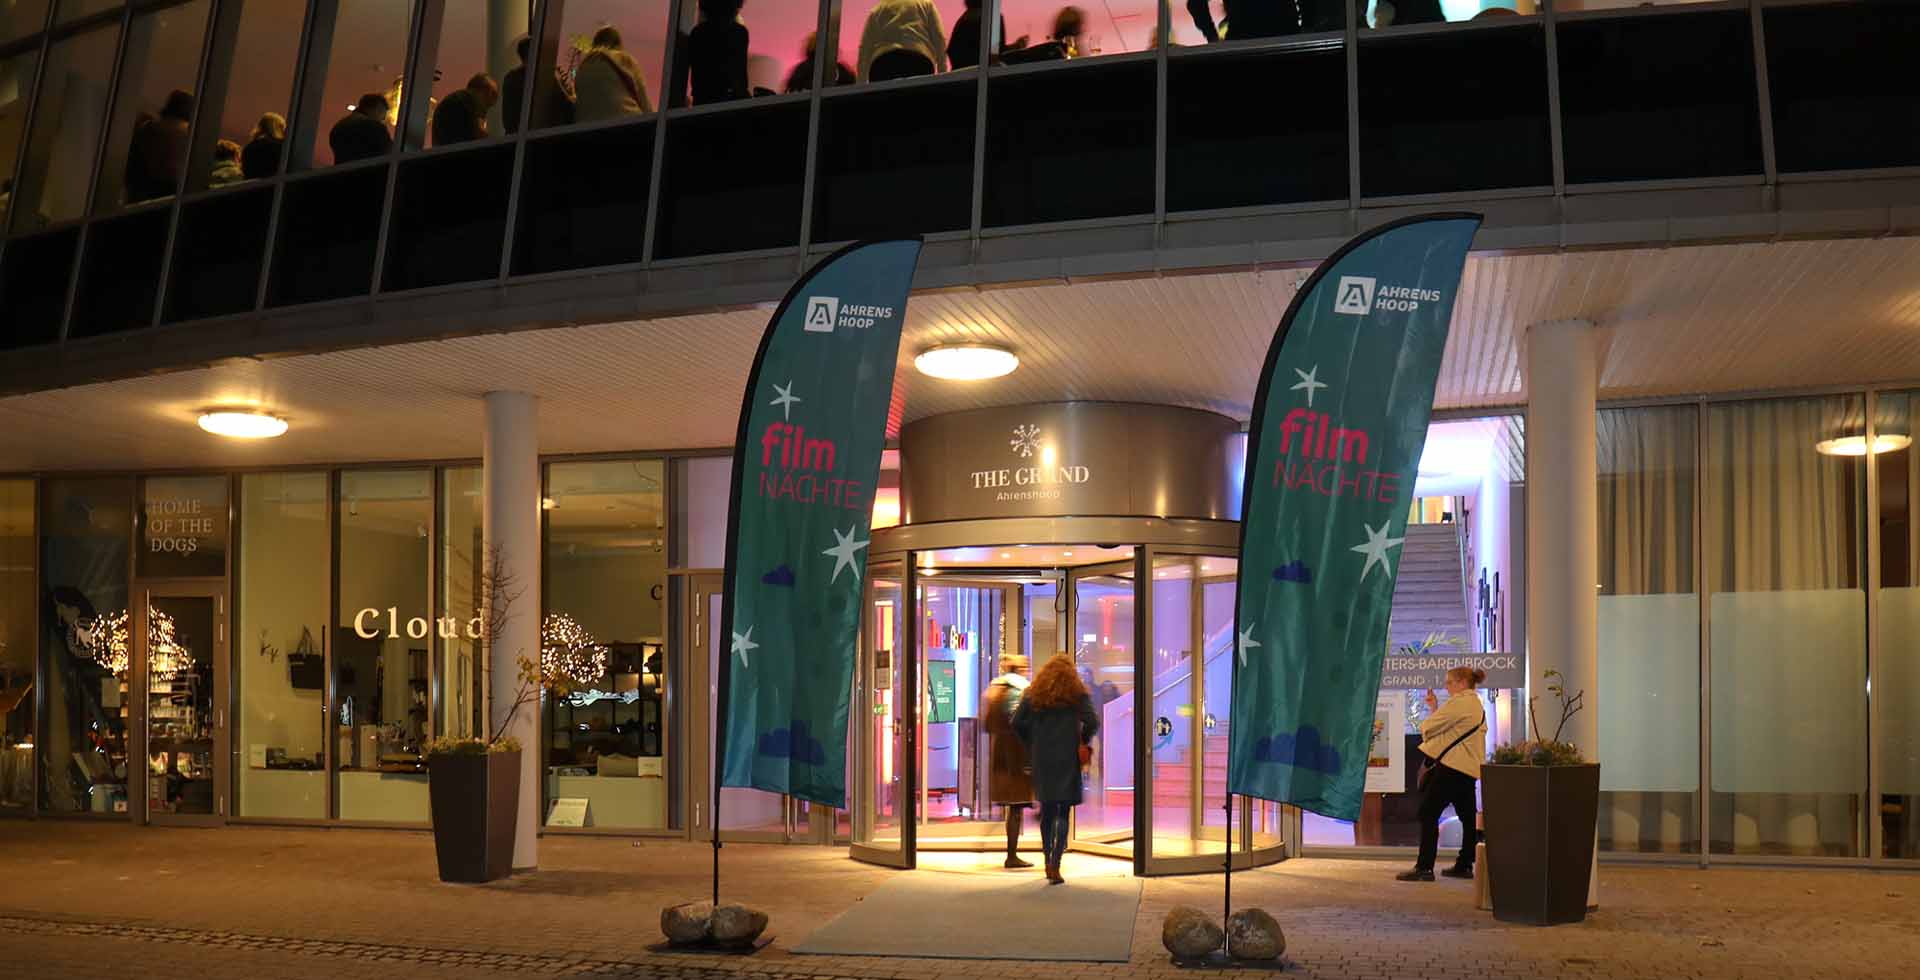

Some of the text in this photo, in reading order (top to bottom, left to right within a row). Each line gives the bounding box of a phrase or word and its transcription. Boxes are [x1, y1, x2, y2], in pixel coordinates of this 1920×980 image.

[1377, 285, 1441, 302] AHRENS
[840, 304, 893, 318] AHRENS
[1375, 298, 1419, 312] HOOP
[838, 316, 875, 329] HOOP
[1280, 408, 1369, 465] film
[761, 421, 836, 473] film
[971, 469, 1010, 488] THE
[151, 499, 201, 513] HOME
[151, 518, 213, 533] OF THE
[151, 537, 198, 552] DOGS
[1382, 656, 1517, 671] TERS-BARENBROCK
[1382, 675, 1425, 687] GRAND
